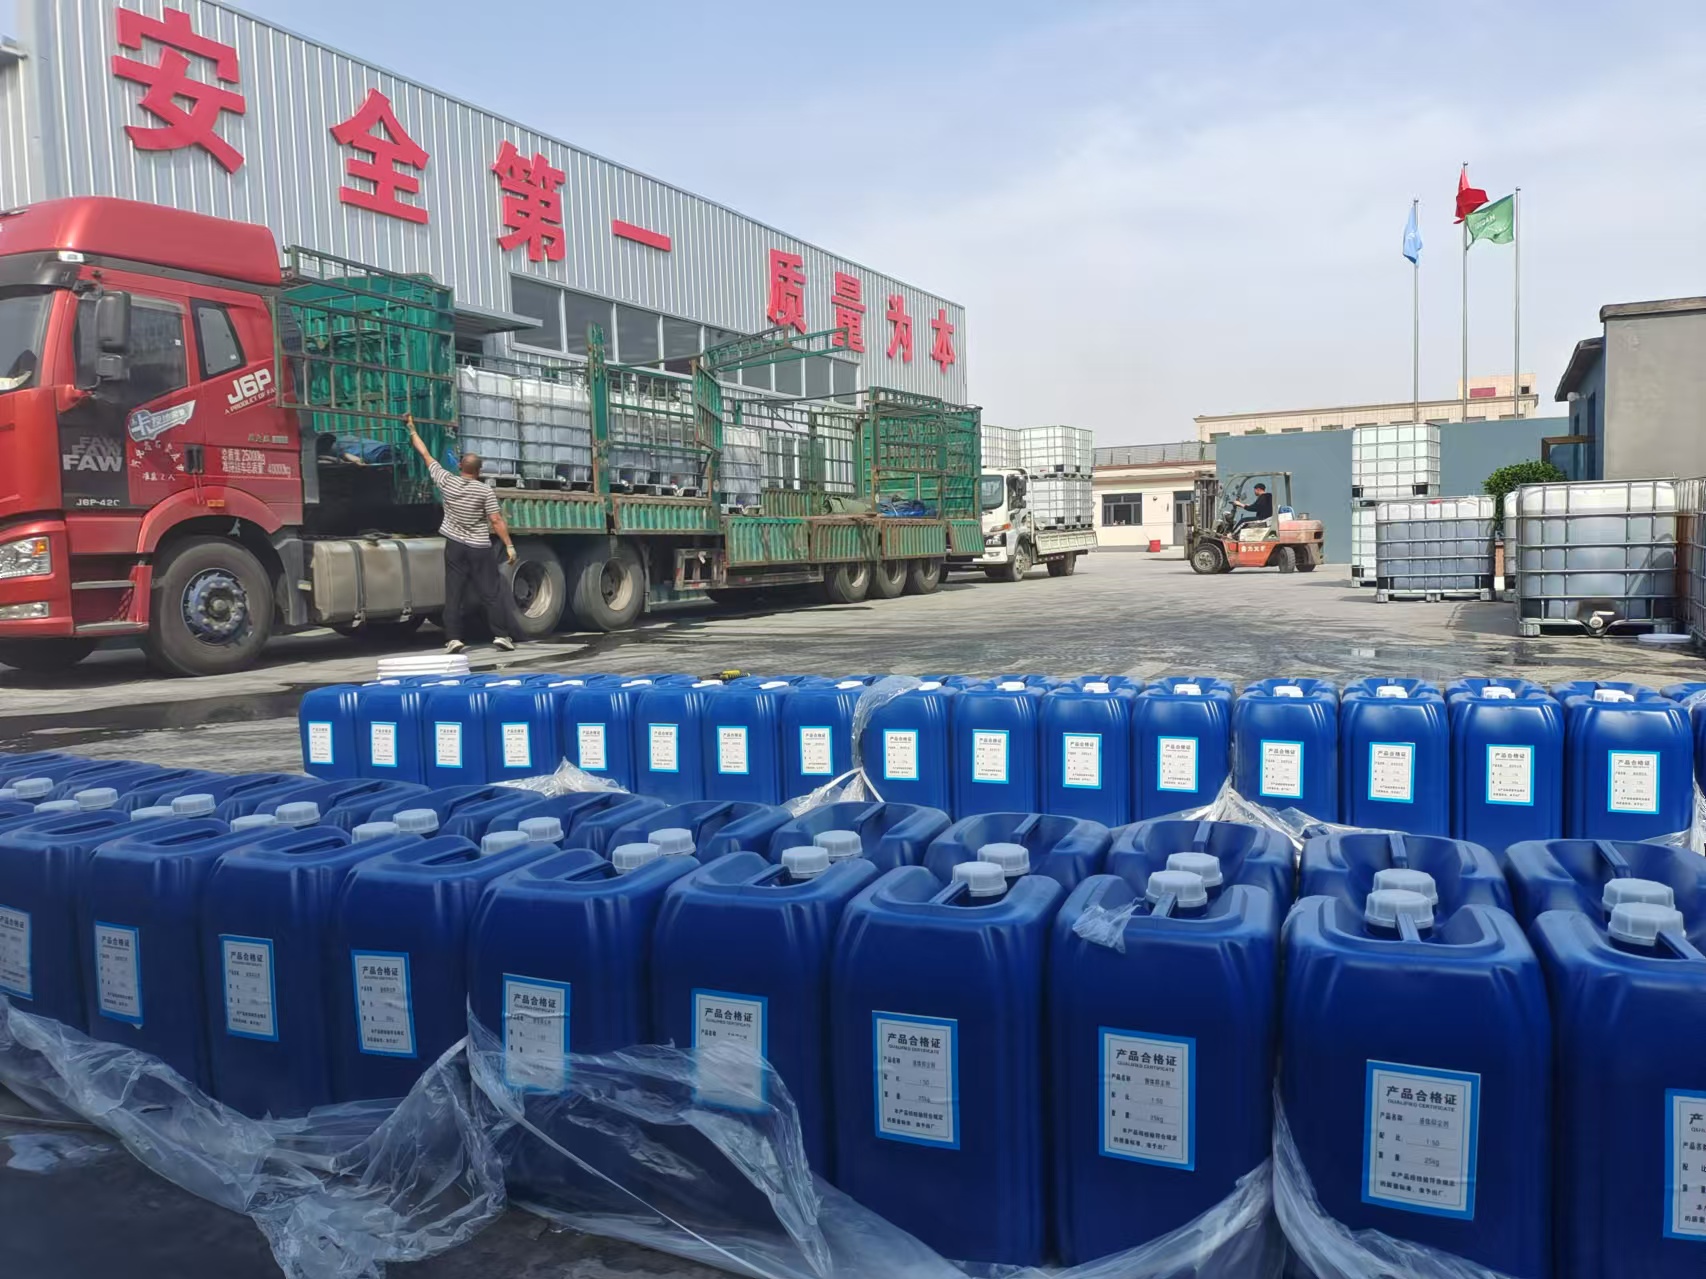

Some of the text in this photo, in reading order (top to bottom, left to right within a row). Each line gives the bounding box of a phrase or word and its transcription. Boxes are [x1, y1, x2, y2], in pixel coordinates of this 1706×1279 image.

[112, 5, 956, 373] 安全第一 质量为本
[227, 368, 272, 405] J6P
[62, 454, 123, 472] FAW
[231, 951, 264, 963] 产品合格证
[362, 966, 399, 976] 产品合格证
[513, 993, 557, 1009] 产品合格证
[705, 1008, 753, 1022] 产品合格证
[888, 1033, 940, 1048] 产品合格证
[1116, 1049, 1177, 1066] 产品合格证
[1386, 1086, 1457, 1105] 产品合格证
